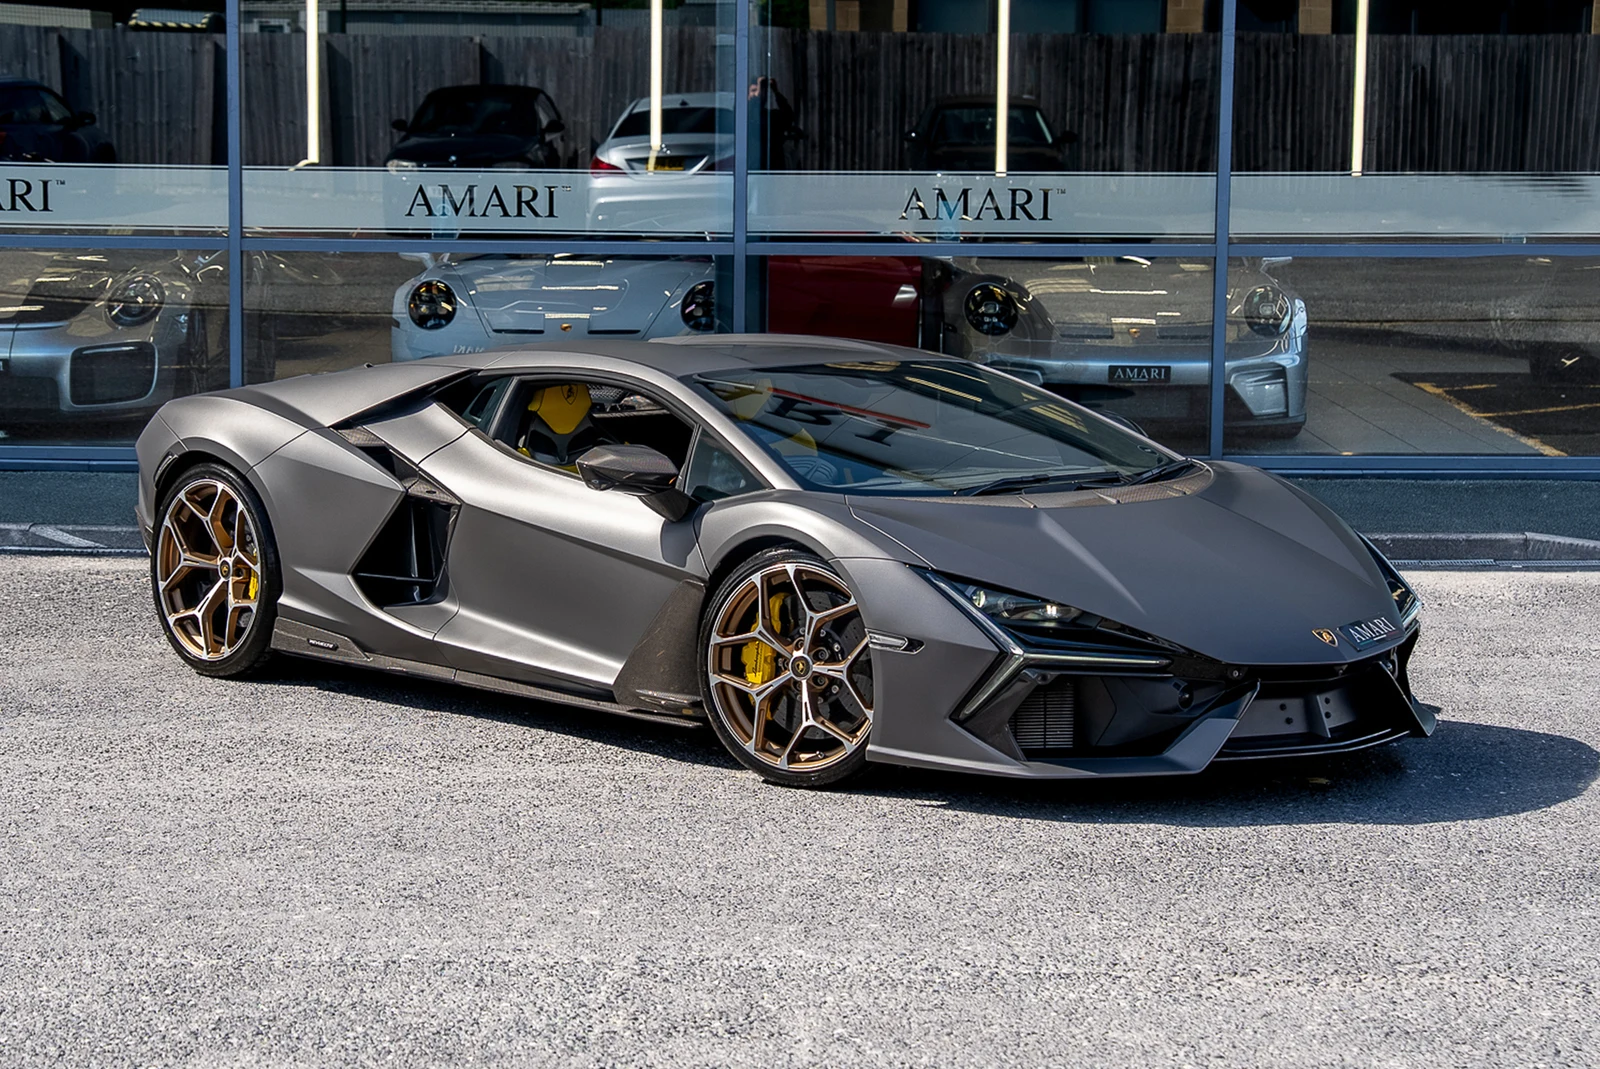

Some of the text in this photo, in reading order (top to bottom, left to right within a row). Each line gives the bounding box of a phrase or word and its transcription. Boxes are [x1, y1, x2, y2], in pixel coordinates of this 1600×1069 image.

[0, 178, 53, 212] RI
[405, 184, 559, 218] AMARI
[899, 187, 1053, 221] AMARI
[1114, 367, 1165, 379] AMARI
[1349, 617, 1396, 643] AMARI
